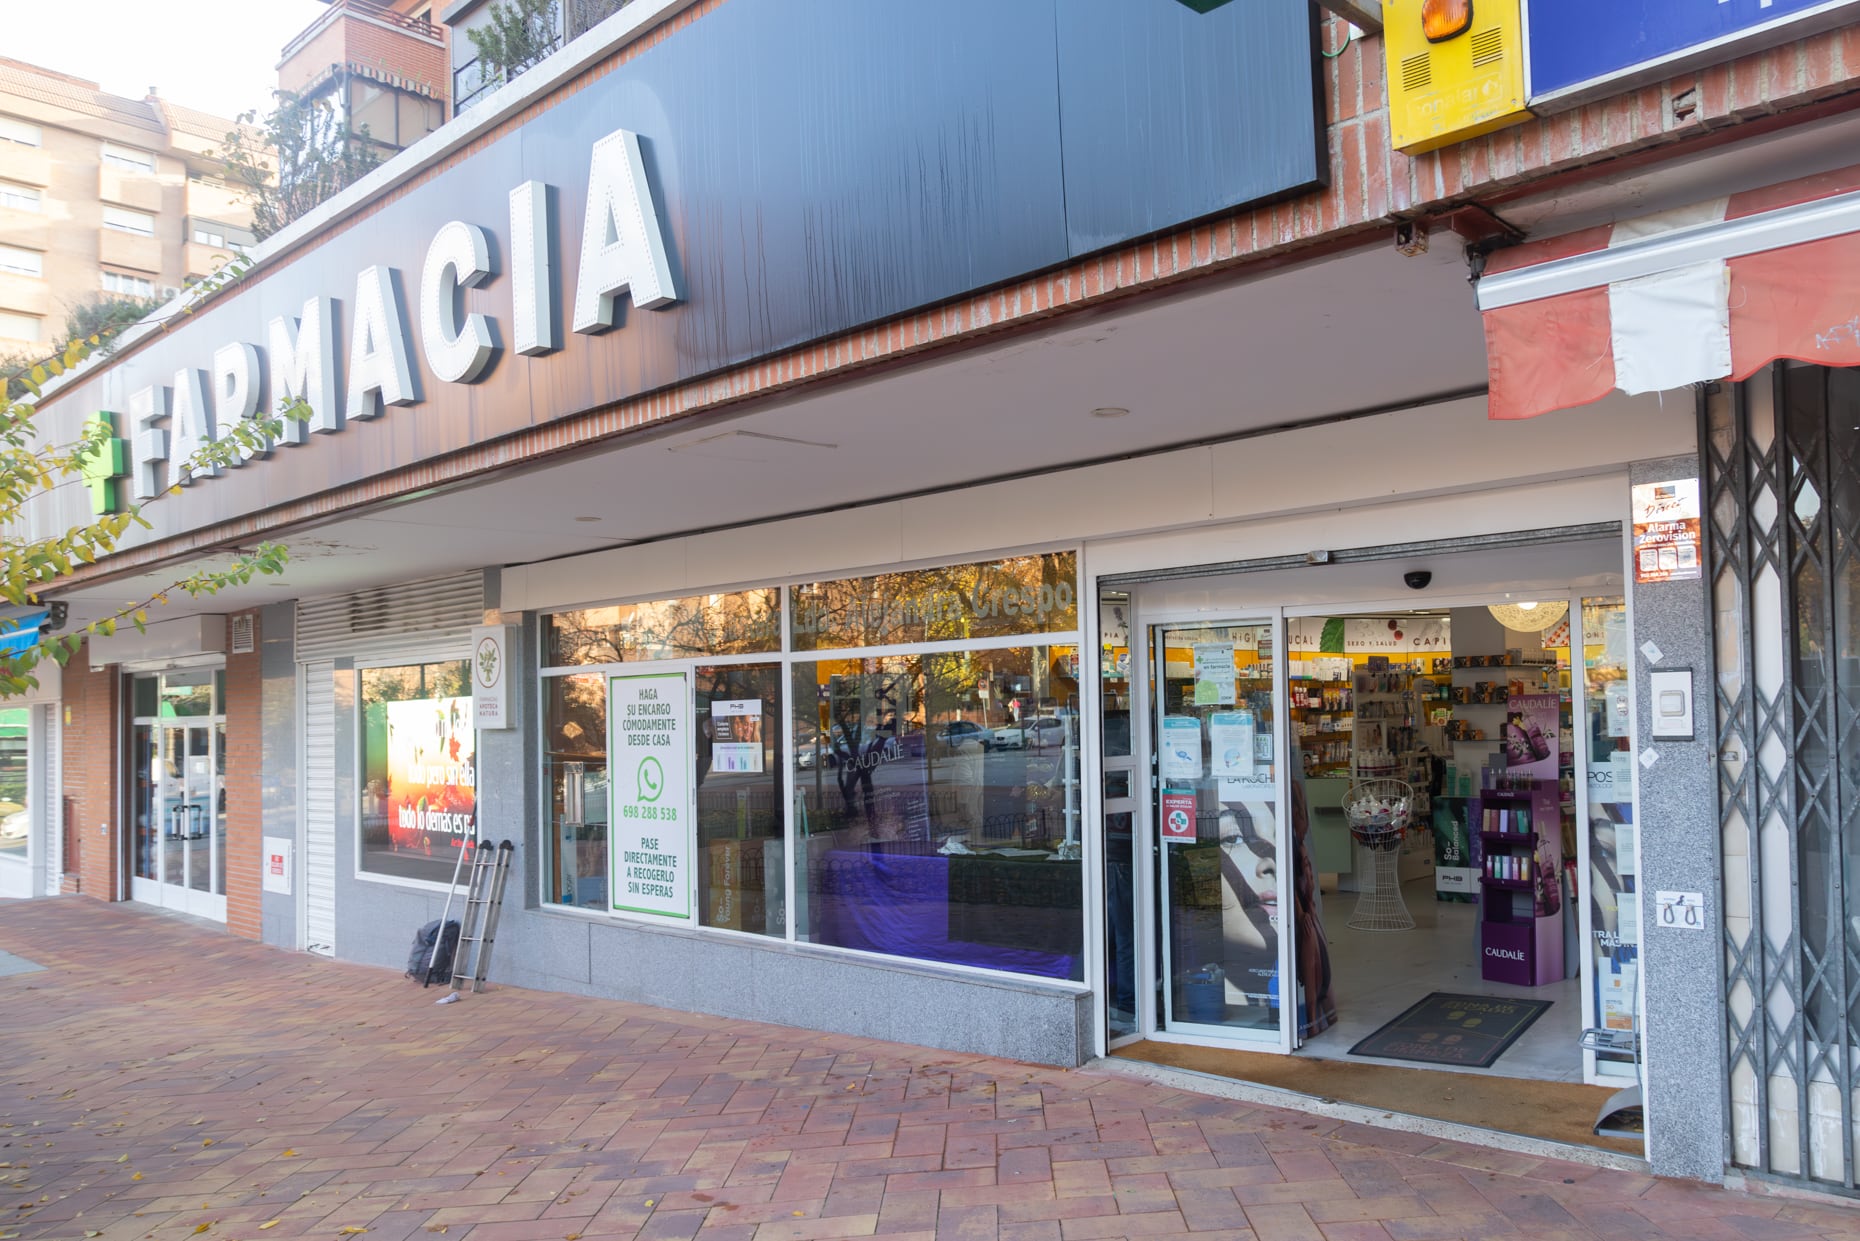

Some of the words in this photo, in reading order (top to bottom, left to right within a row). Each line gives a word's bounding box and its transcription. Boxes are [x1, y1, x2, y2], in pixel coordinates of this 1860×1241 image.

[129, 128, 676, 499] FARMACIA
[1647, 522, 1686, 533] Alarma
[1639, 531, 1696, 543] Zerovision
[971, 580, 1073, 624] Crespo
[1412, 637, 1447, 646] CAPI
[639, 688, 658, 700] HAGA
[627, 704, 636, 716] SU
[638, 703, 671, 716] ENCARGO
[622, 718, 676, 731] COMODAMENTE
[627, 734, 650, 746] DESDE
[652, 734, 671, 746] CASA
[426, 765, 445, 788] pero
[446, 764, 458, 786] sin
[459, 762, 475, 787] ella
[398, 804, 416, 829] todo
[417, 805, 425, 831] lo
[425, 805, 452, 834] demás
[452, 815, 463, 834] es
[623, 805, 639, 818] 698
[641, 806, 657, 820] 288
[660, 807, 677, 821] 538
[641, 837, 659, 850] PASE
[1452, 820, 1460, 861] Balanced
[1443, 841, 1453, 861] So-
[624, 851, 677, 868] DIRECTAMENTE
[723, 846, 731, 885] Forever
[626, 866, 632, 878] A
[633, 867, 675, 883] RECOGERLO
[628, 881, 640, 894] SIN
[642, 883, 674, 899] ESPERAS
[1485, 946, 1525, 961] CAUDALÍE
